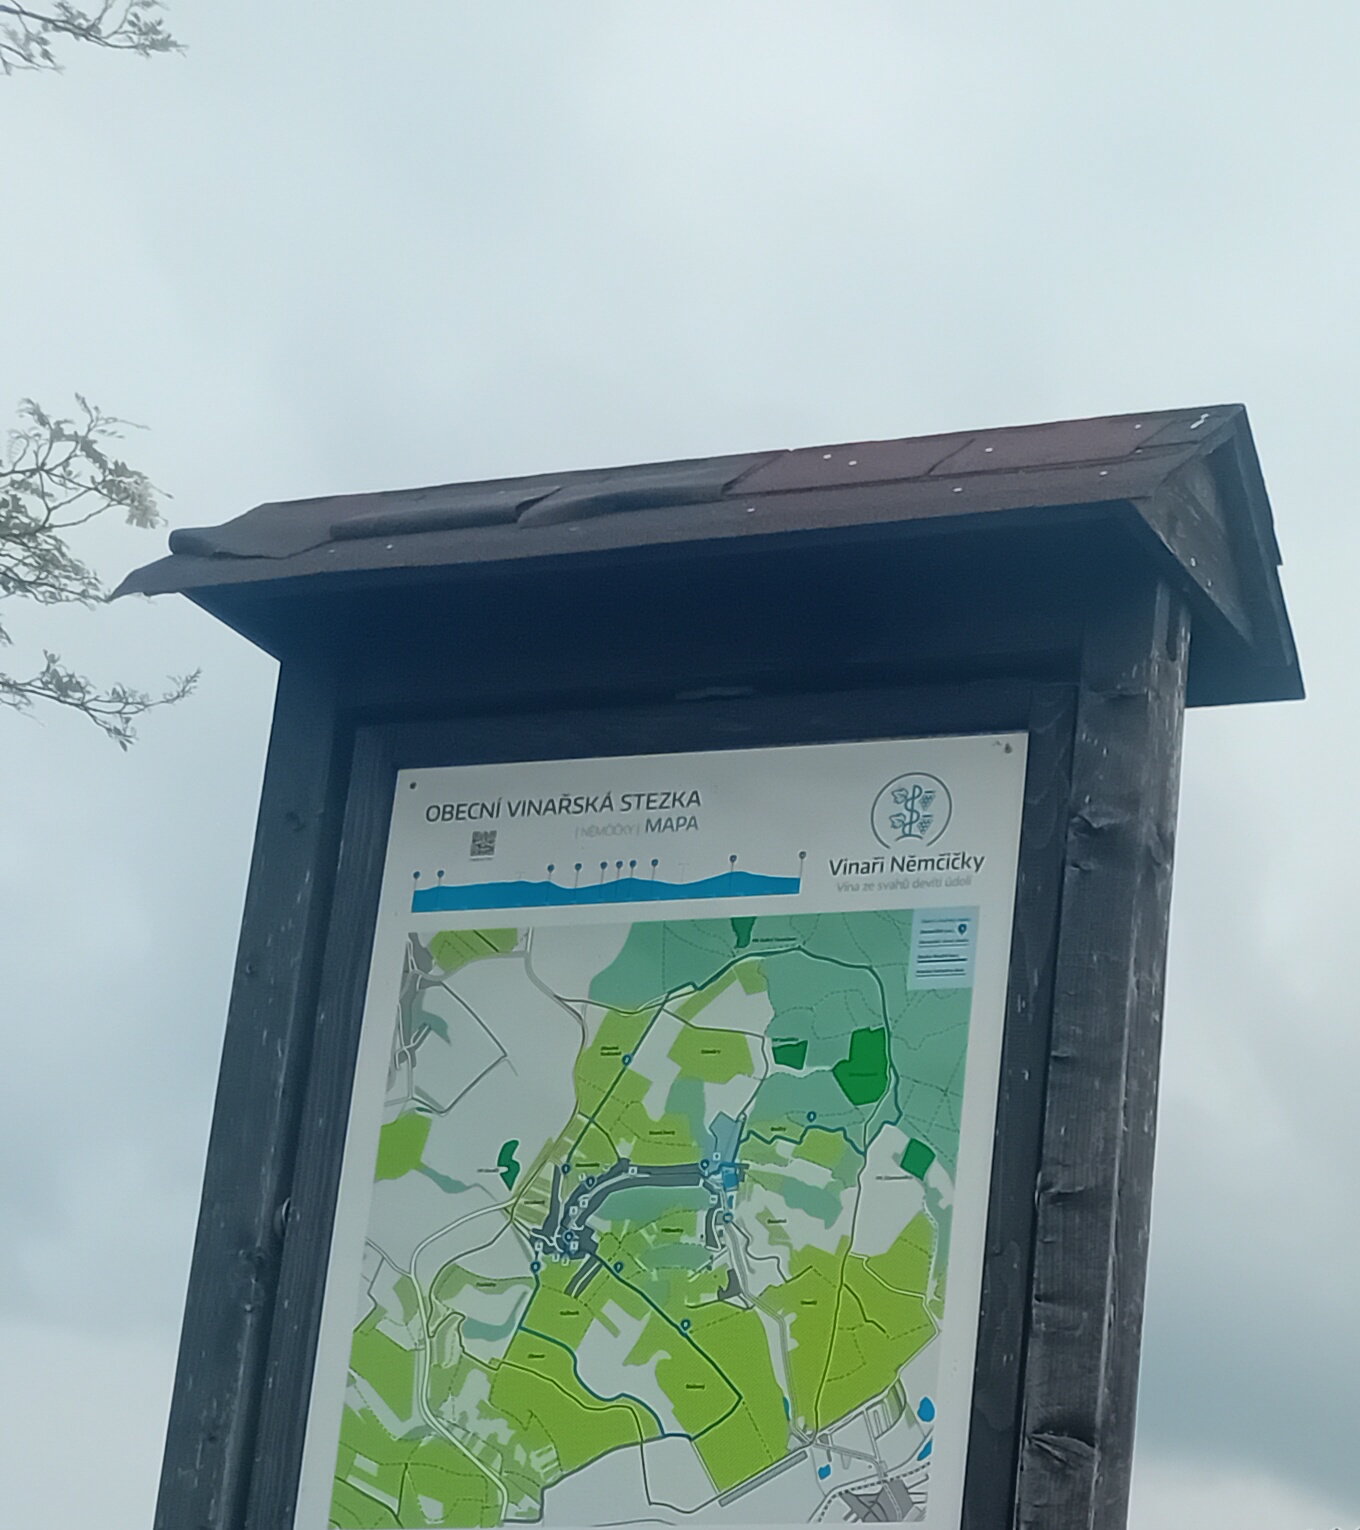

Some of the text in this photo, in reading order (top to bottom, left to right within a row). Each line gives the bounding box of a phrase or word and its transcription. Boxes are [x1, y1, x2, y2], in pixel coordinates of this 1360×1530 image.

[425, 790, 702, 823] OBECNÍ VINAŘSKÁ STEZKA
[644, 815, 699, 834] MAPA
[828, 851, 986, 877] Vinaři Němčičky
